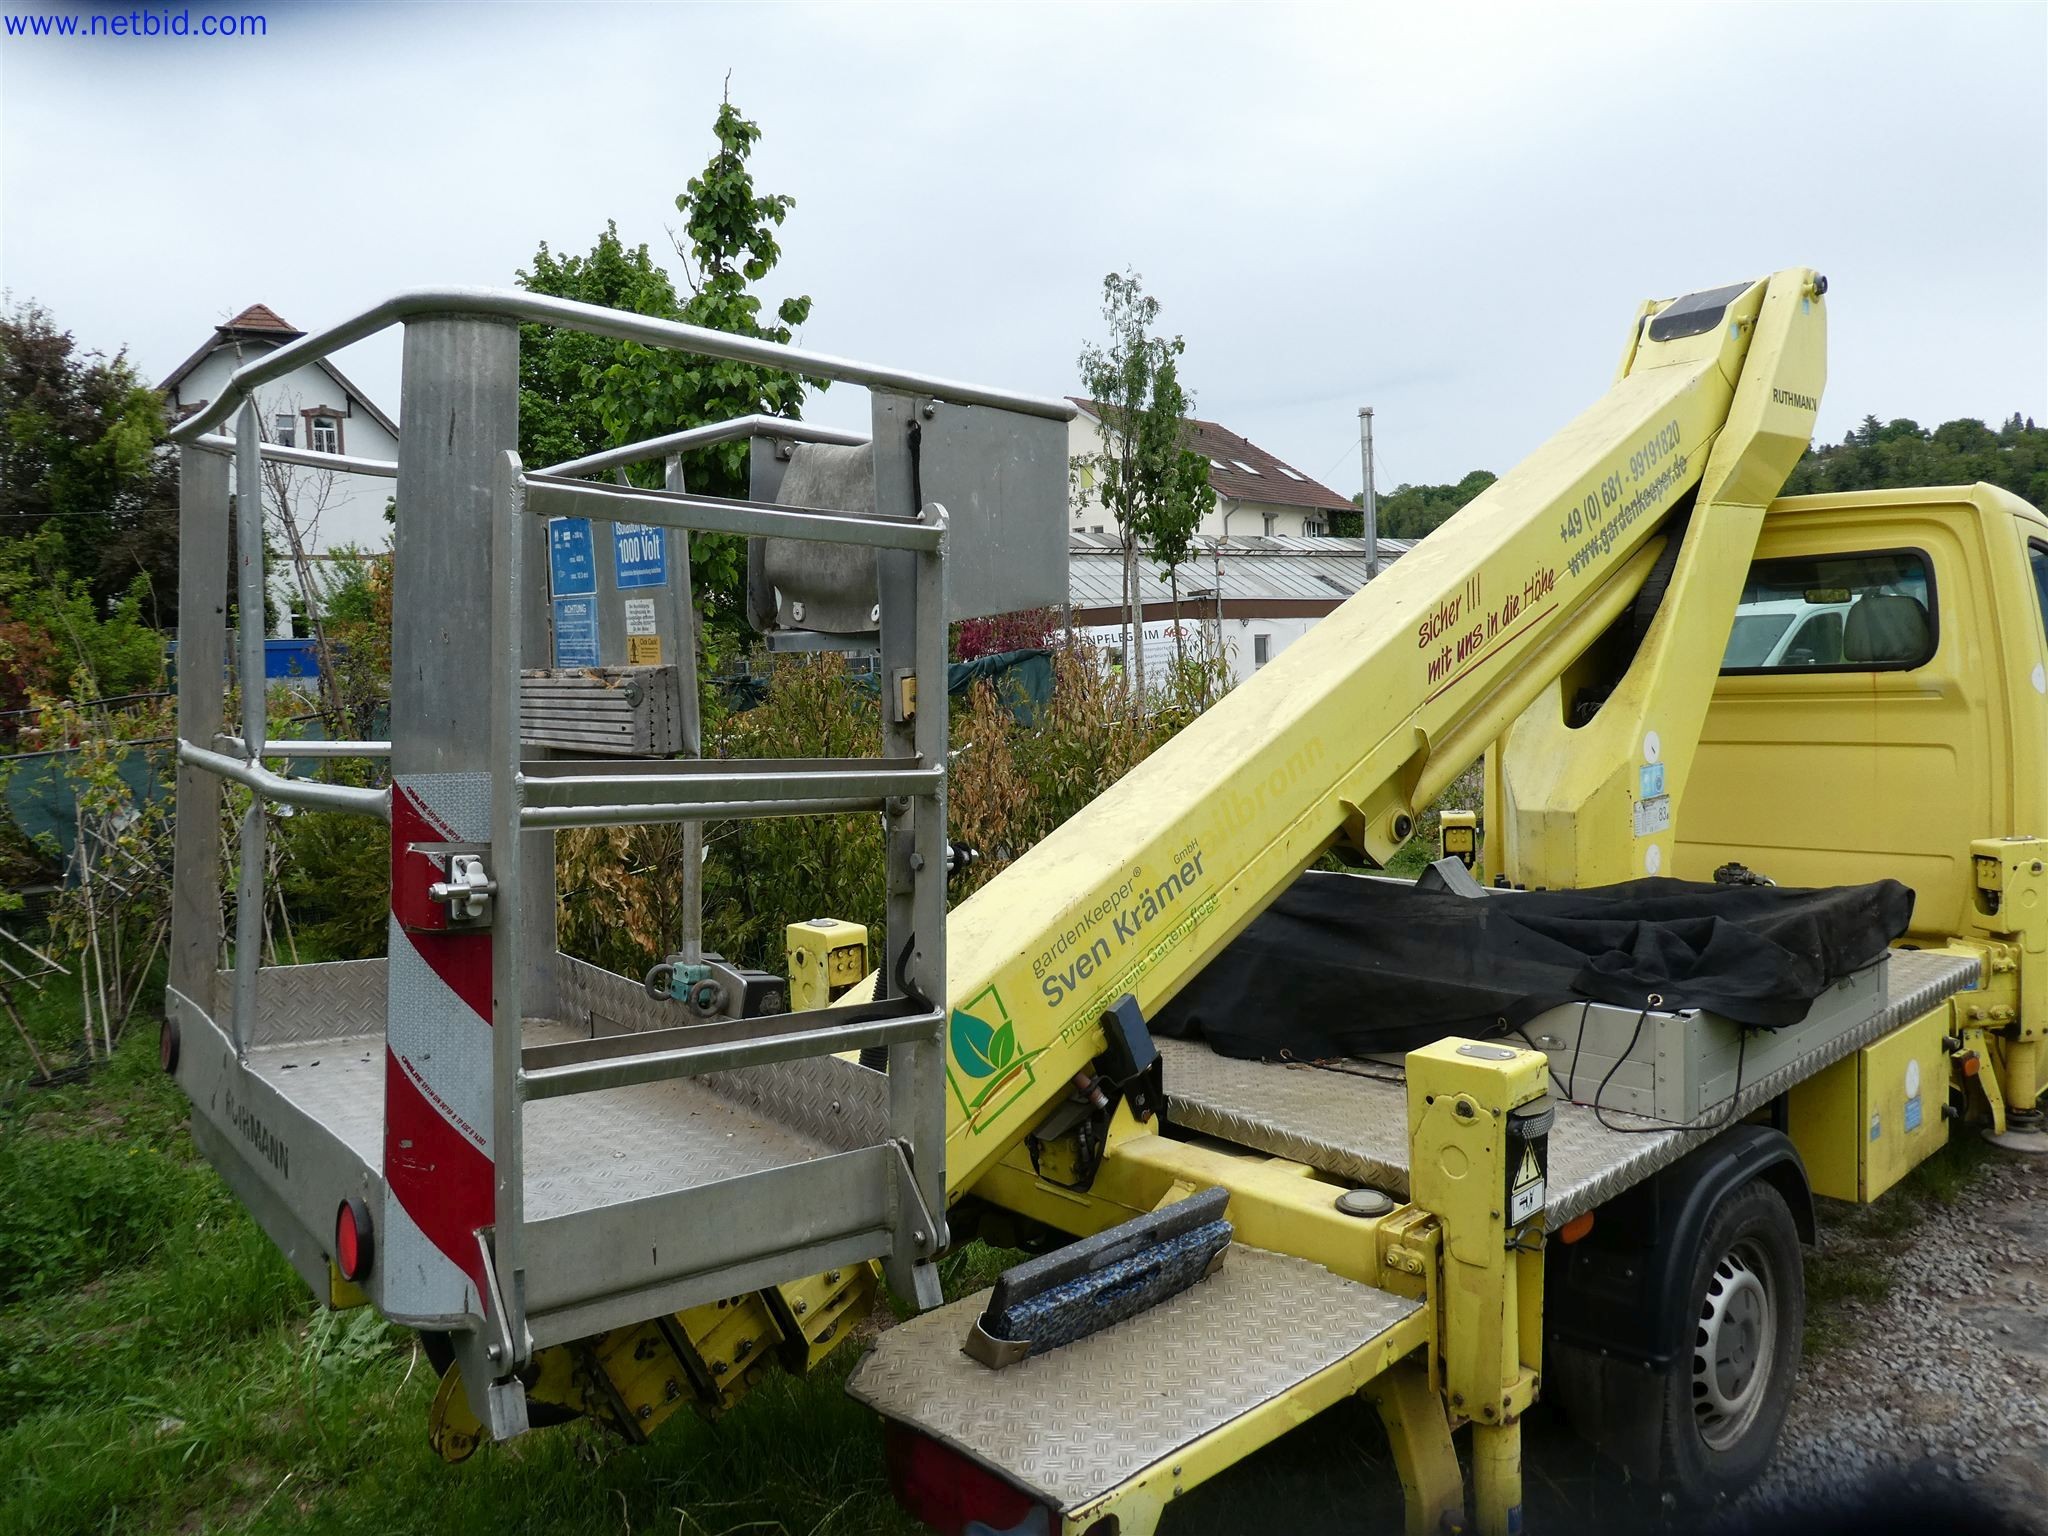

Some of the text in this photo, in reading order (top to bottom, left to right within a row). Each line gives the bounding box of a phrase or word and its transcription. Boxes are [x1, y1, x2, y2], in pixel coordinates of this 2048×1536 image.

[1560, 511, 1582, 543] +49
[1583, 491, 1602, 532] (0)
[1602, 470, 1624, 509] 681
[1629, 419, 1681, 479] 99191820
[1568, 453, 1687, 578] www.gardenkeeper.de
[619, 534, 661, 563] 1000 Volt
[1144, 629, 1159, 640] IM
[1418, 592, 1461, 649] sicher
[1428, 567, 1554, 685] mit uns in die Höhe
[1173, 838, 1199, 865] GmbH
[1043, 851, 1205, 1008] Sven Krämer
[1147, 892, 1220, 961] Gartenpflege
